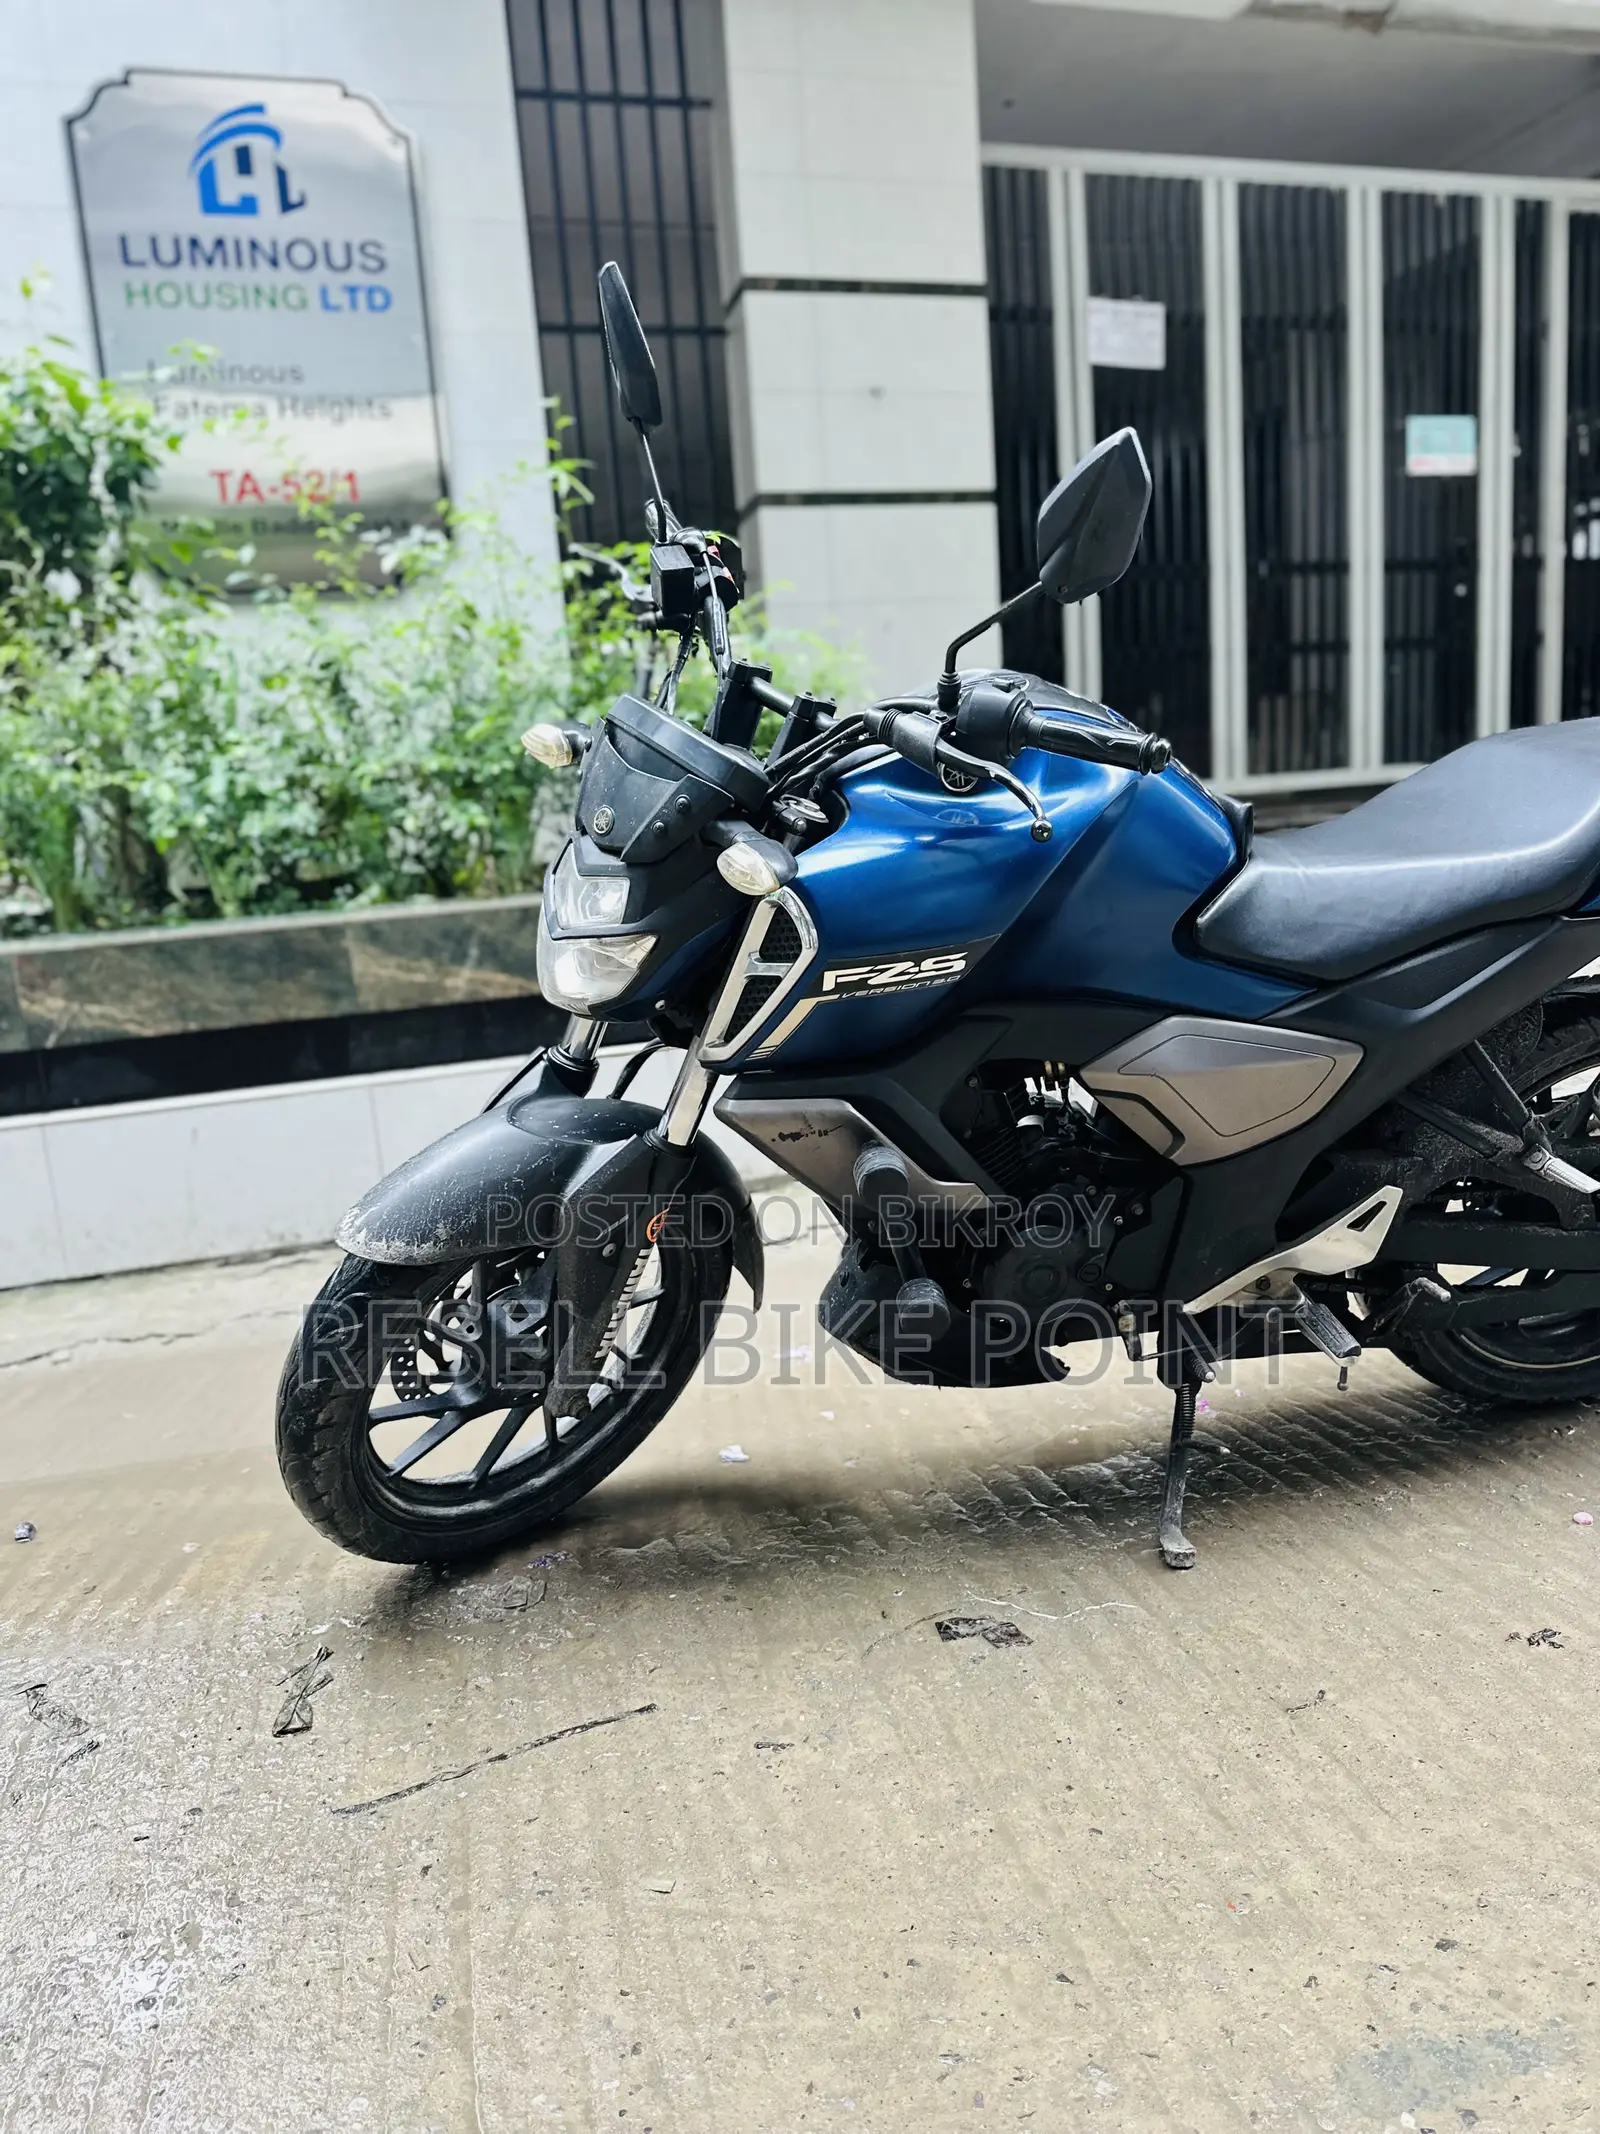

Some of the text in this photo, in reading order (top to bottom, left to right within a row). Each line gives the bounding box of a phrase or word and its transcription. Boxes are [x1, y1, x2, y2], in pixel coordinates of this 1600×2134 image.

[119, 234, 388, 275] LUMINOUS
[123, 282, 393, 313] HOUSING LTD
[276, 396, 394, 426] Heights
[841, 981, 931, 999] VERSION
